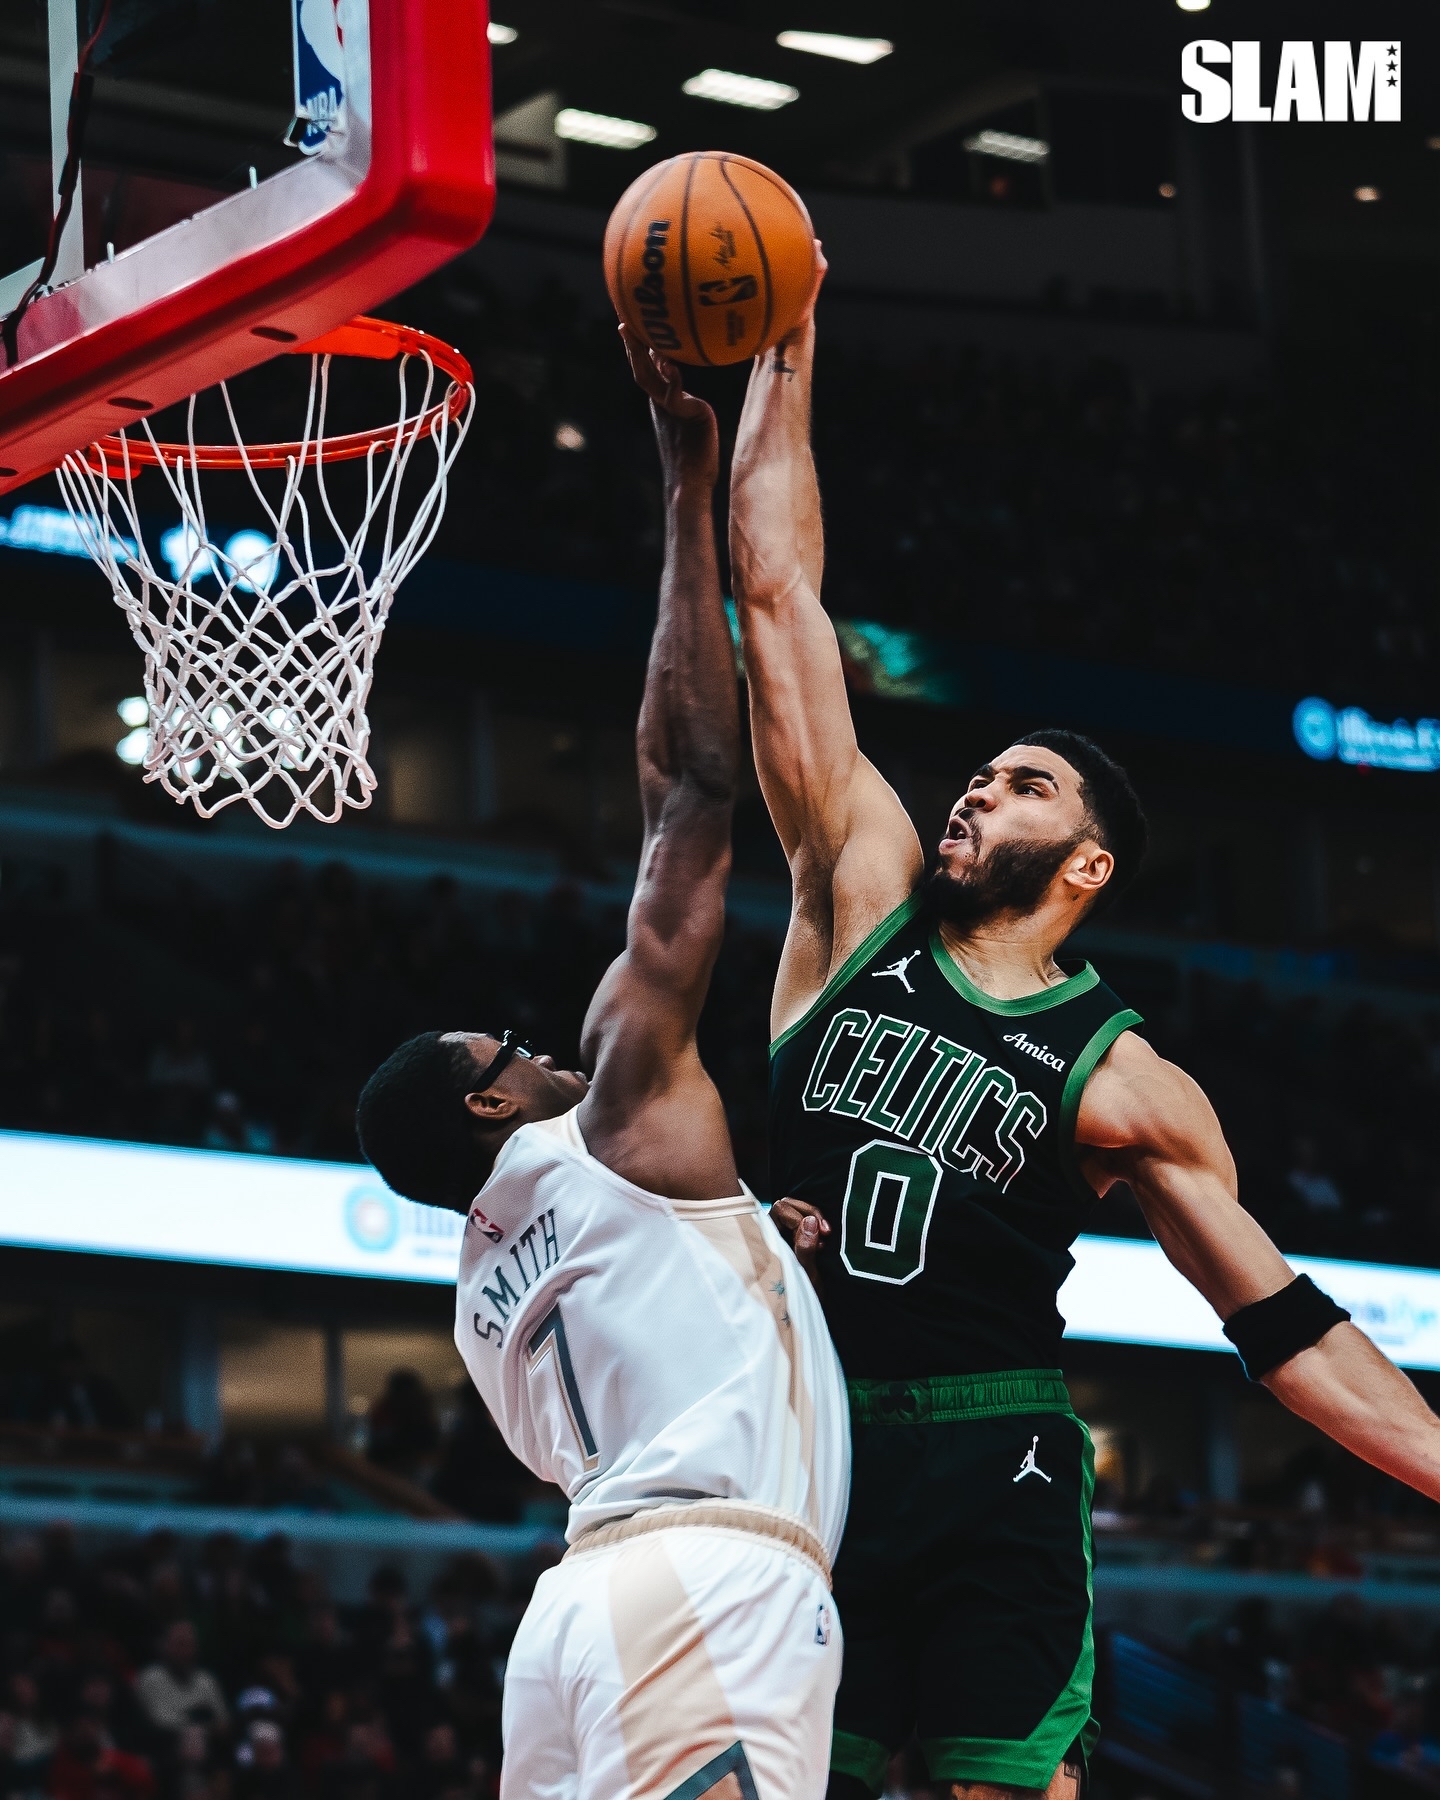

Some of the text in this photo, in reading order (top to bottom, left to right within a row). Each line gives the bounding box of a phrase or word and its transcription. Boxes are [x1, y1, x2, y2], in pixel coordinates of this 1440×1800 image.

[634, 220, 682, 350] Wilson
[802, 1008, 1047, 1193] CELTICS
[1003, 1033, 1066, 1072] Amica
[474, 1208, 560, 1349] SMITH
[840, 1139, 943, 1285] 0
[526, 1301, 600, 1473] 7
